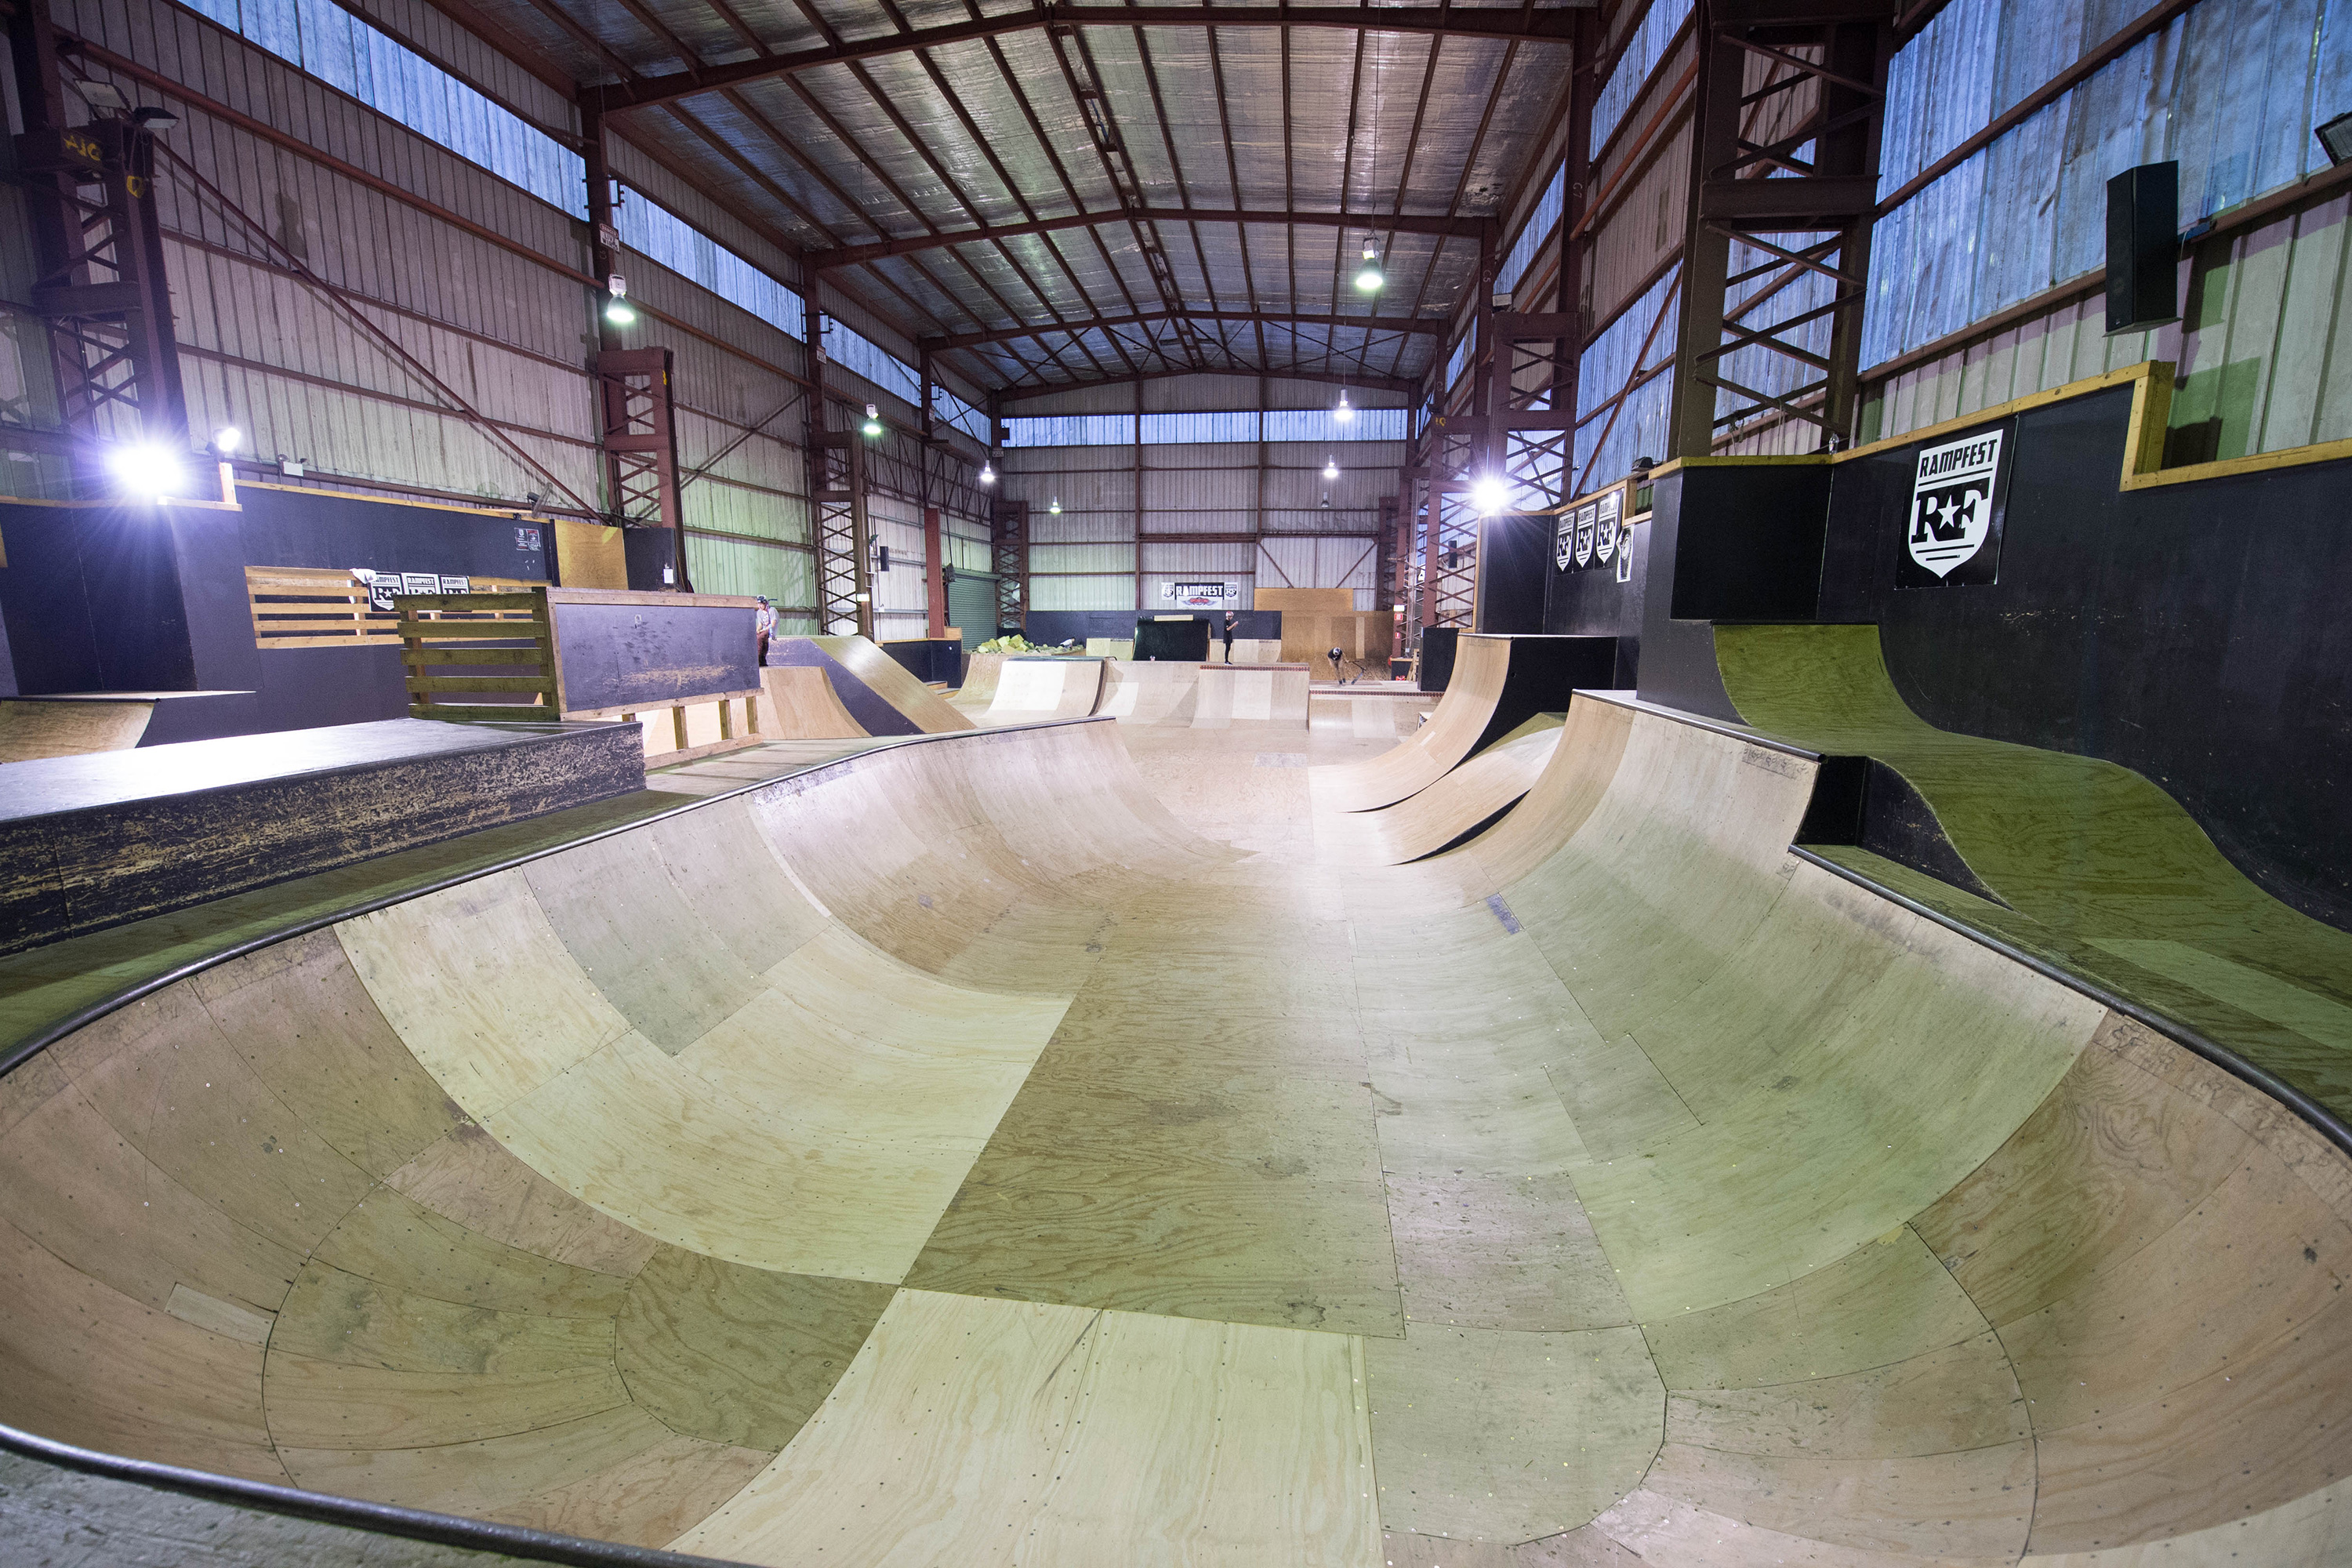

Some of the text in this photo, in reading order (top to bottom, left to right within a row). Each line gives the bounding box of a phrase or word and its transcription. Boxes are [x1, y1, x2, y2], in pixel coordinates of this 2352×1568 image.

[1919, 438, 1998, 478] RAMPFEST
[1578, 508, 1595, 522] RAMPFEST
[1176, 586, 1223, 596] RAMPFEST
